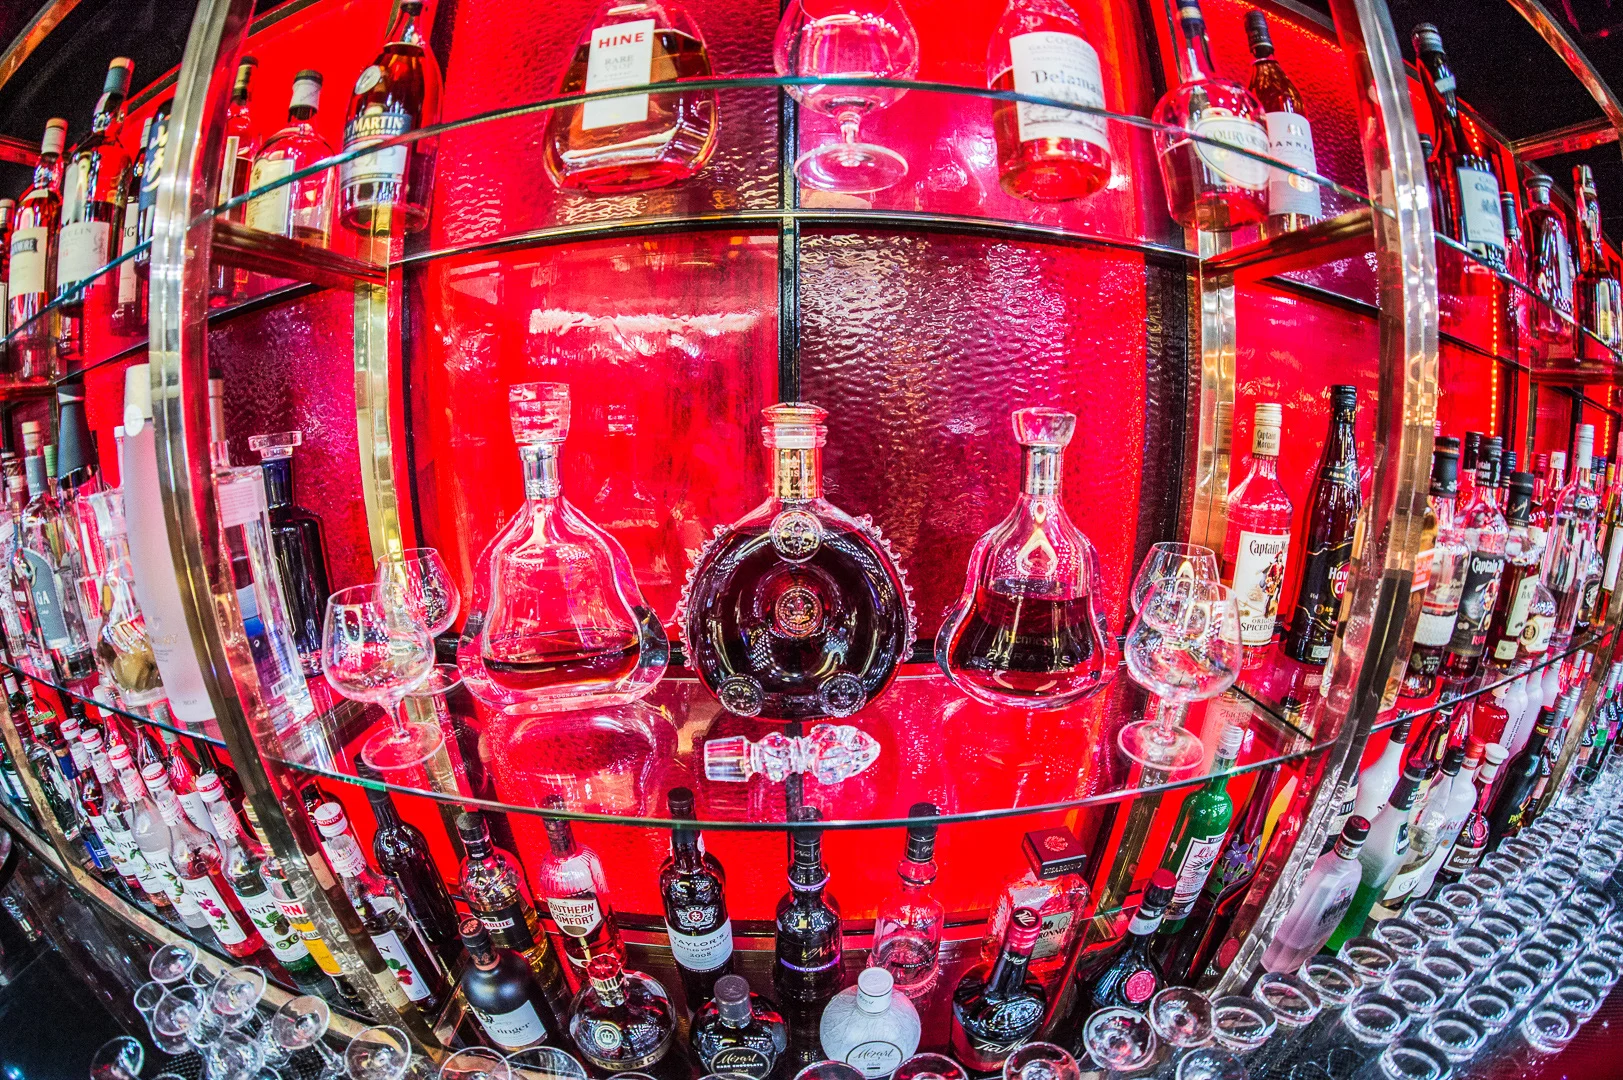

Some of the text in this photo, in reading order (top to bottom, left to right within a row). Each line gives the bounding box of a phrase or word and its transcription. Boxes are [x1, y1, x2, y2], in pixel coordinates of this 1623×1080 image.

[598, 32, 645, 49] HINE
[604, 55, 634, 65] RARE
[1031, 69, 1102, 94] Delamai
[353, 115, 404, 132] MARTIN
[1249, 539, 1280, 556] Captain
[1472, 557, 1498, 574] Captain
[1328, 566, 1348, 580] Hav
[1334, 581, 1345, 594] Cl
[549, 902, 594, 915] SOUTHERN
[553, 913, 594, 925] COMFORT
[1038, 927, 1066, 939] RONNO
[672, 932, 725, 948] TAYLOR'S
[717, 1052, 757, 1065] Mozart
[854, 1048, 894, 1060] Mozart
